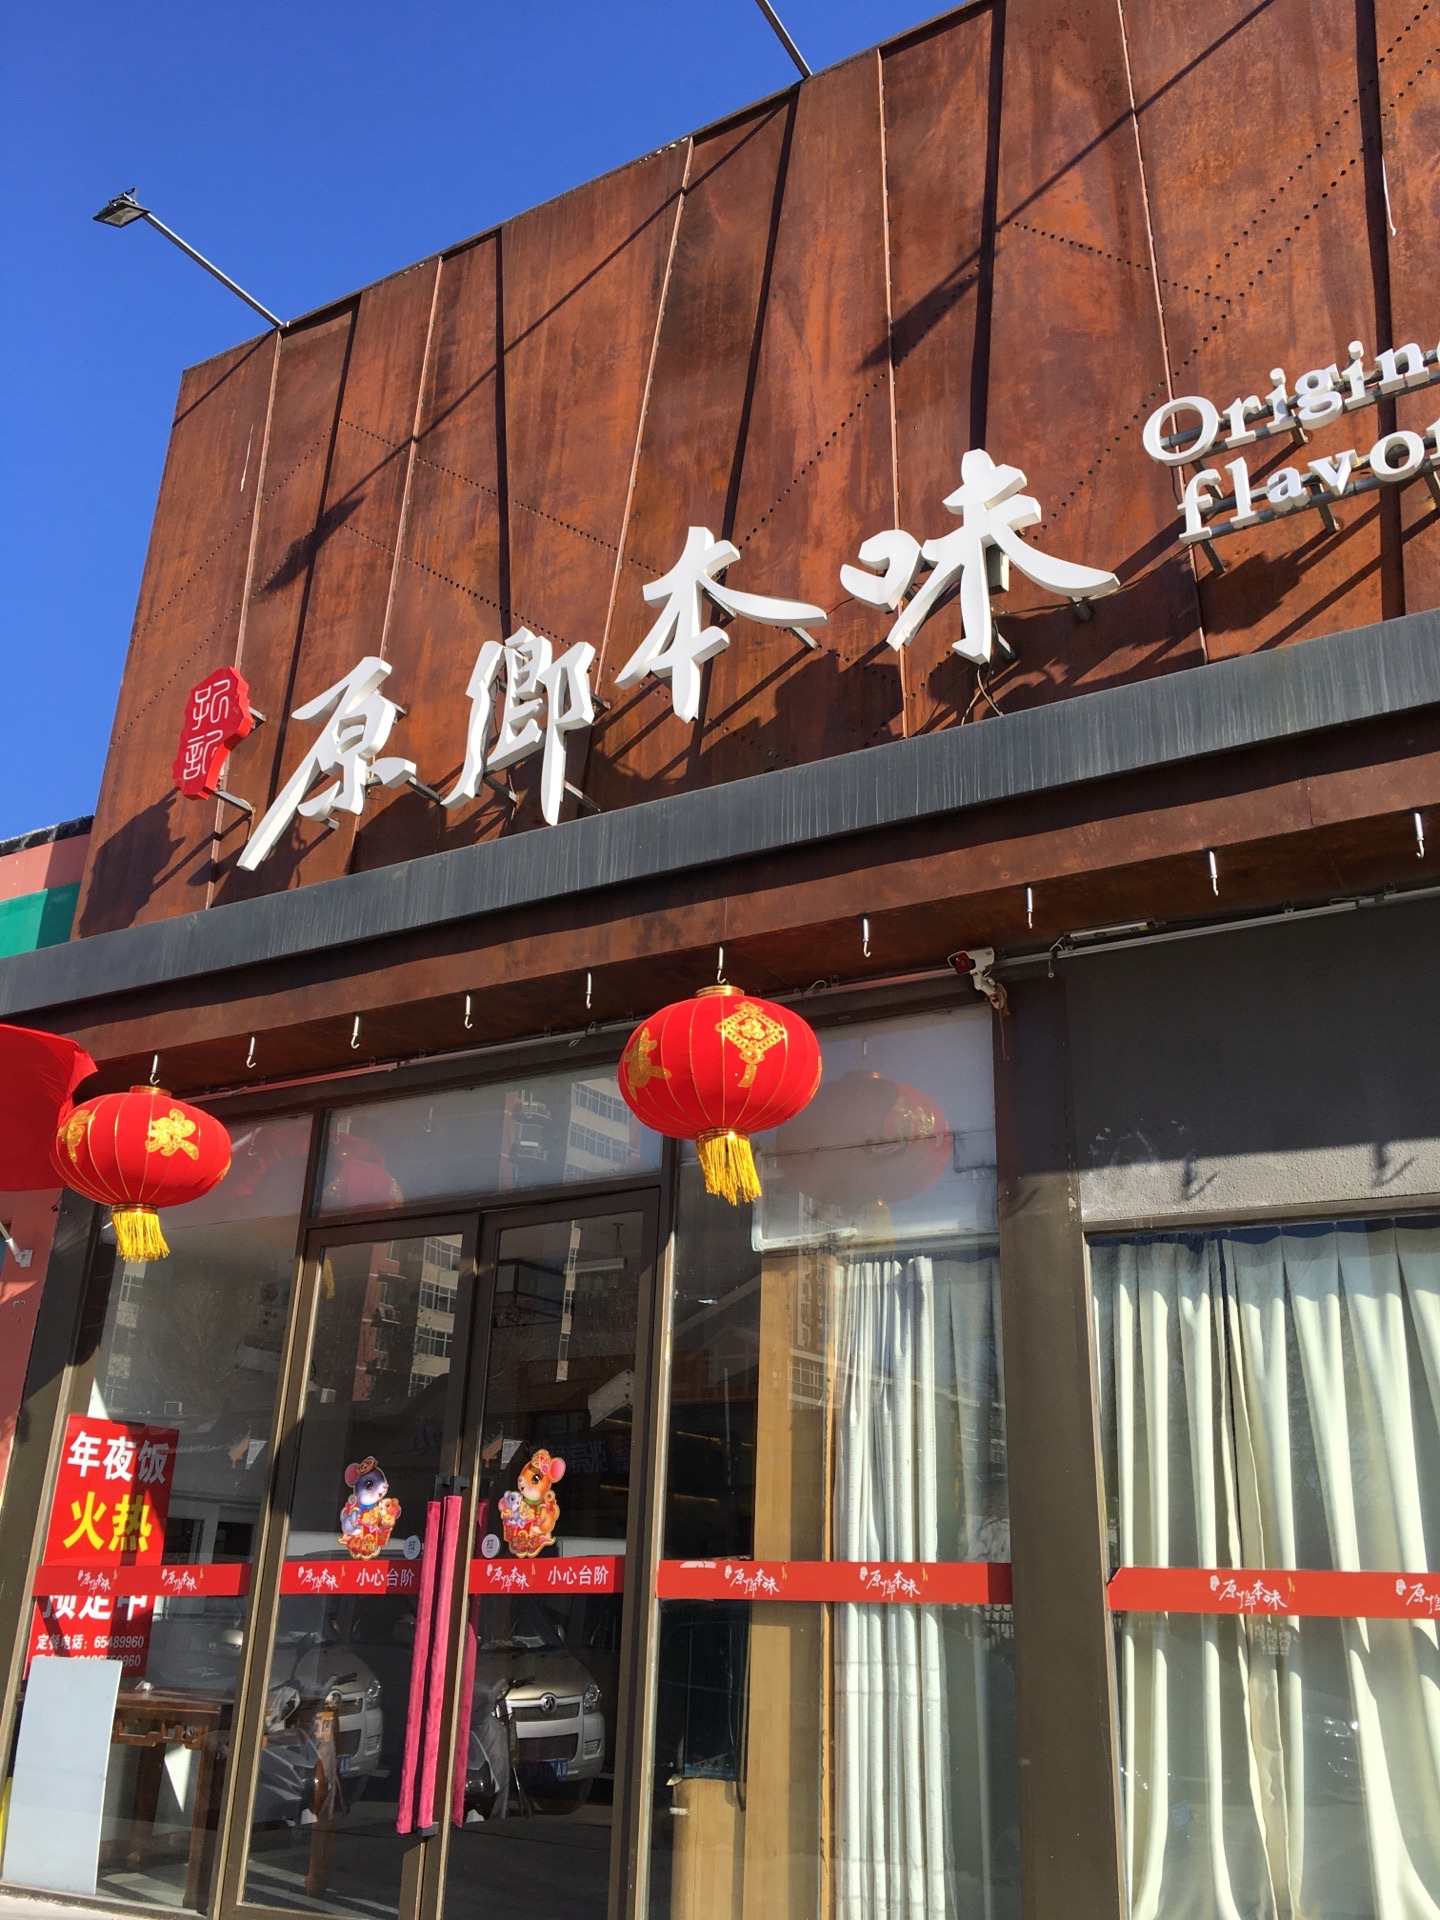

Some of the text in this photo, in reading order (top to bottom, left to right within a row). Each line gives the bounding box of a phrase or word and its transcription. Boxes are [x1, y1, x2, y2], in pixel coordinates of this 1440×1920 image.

[1142, 340, 1440, 467] Origin
[66, 1431, 169, 1484] 年夜饭
[62, 1491, 153, 1553] 火热
[356, 1568, 415, 1587] 小心台阶
[547, 1565, 609, 1585] 小心台阶
